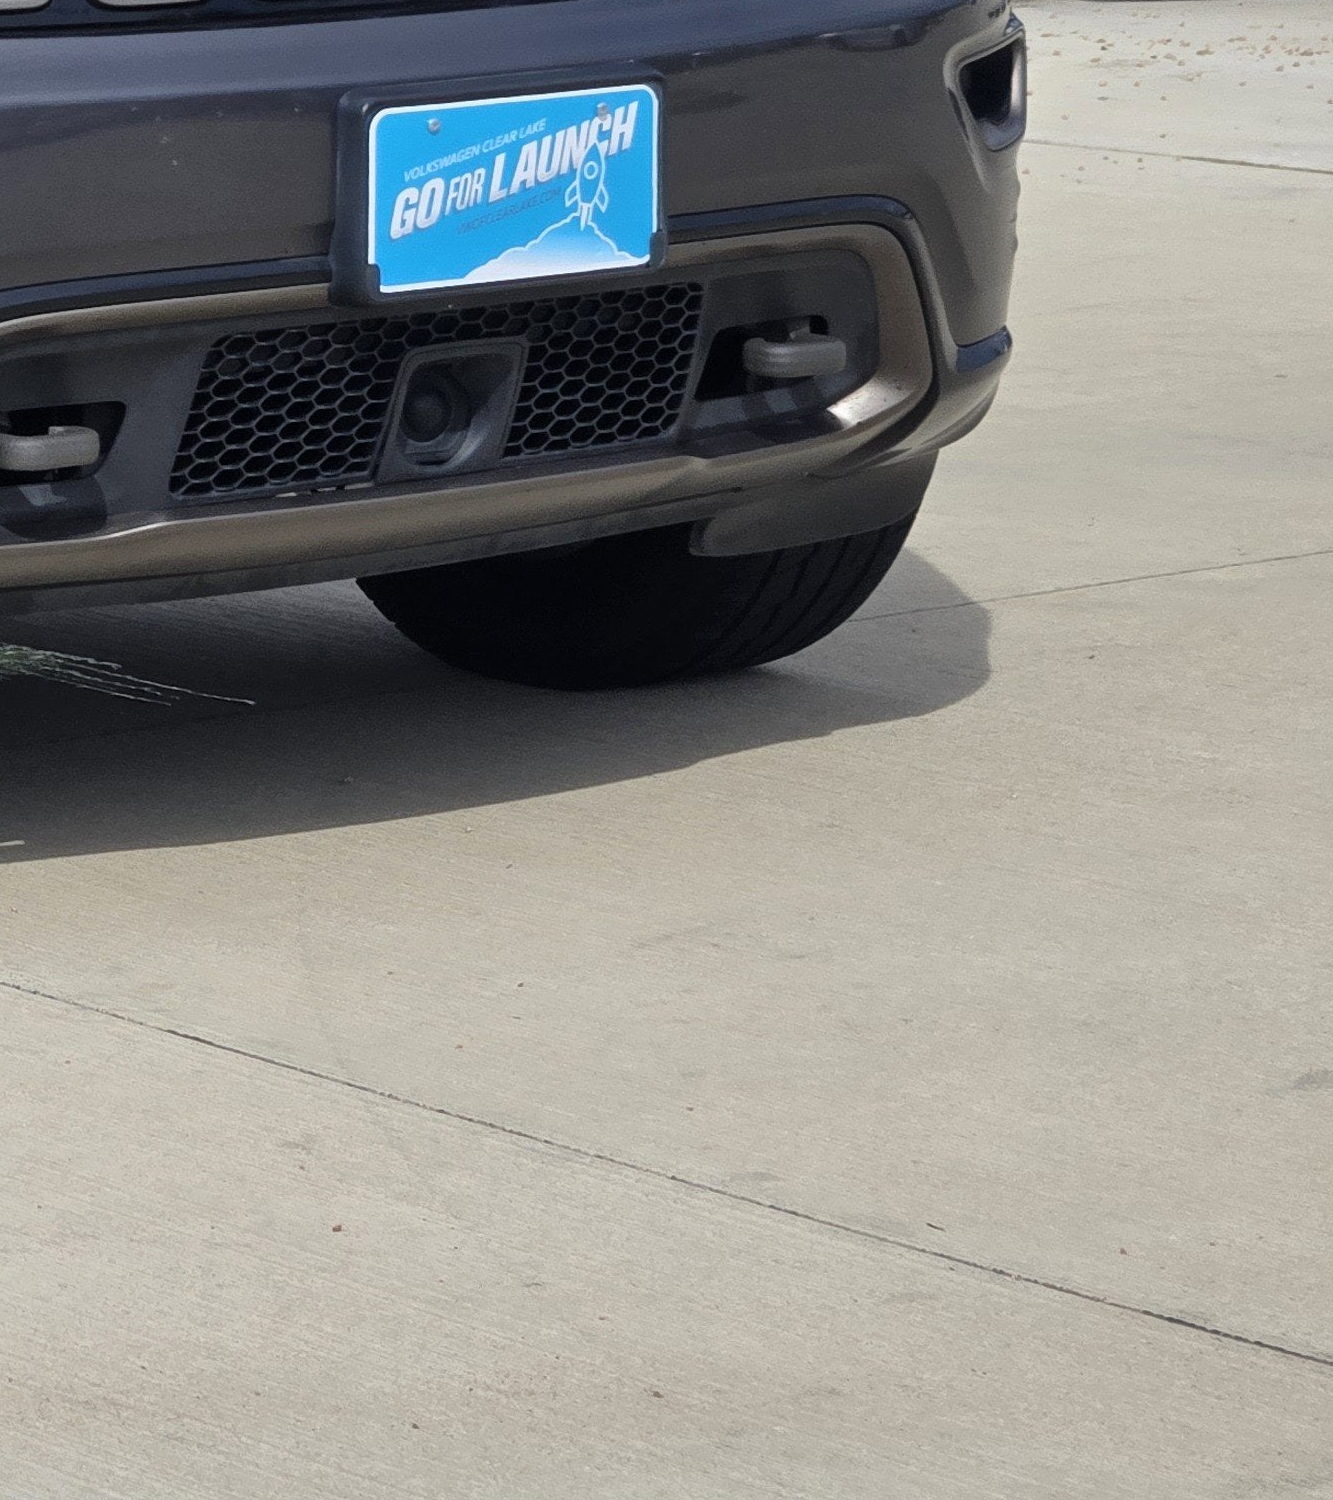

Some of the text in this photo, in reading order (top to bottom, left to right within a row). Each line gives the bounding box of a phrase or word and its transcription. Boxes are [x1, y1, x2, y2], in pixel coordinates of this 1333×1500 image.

[389, 101, 639, 240] GO FOR LAUNCH
[404, 118, 546, 182] VOLKSWAGEN CLEAR LAKE
